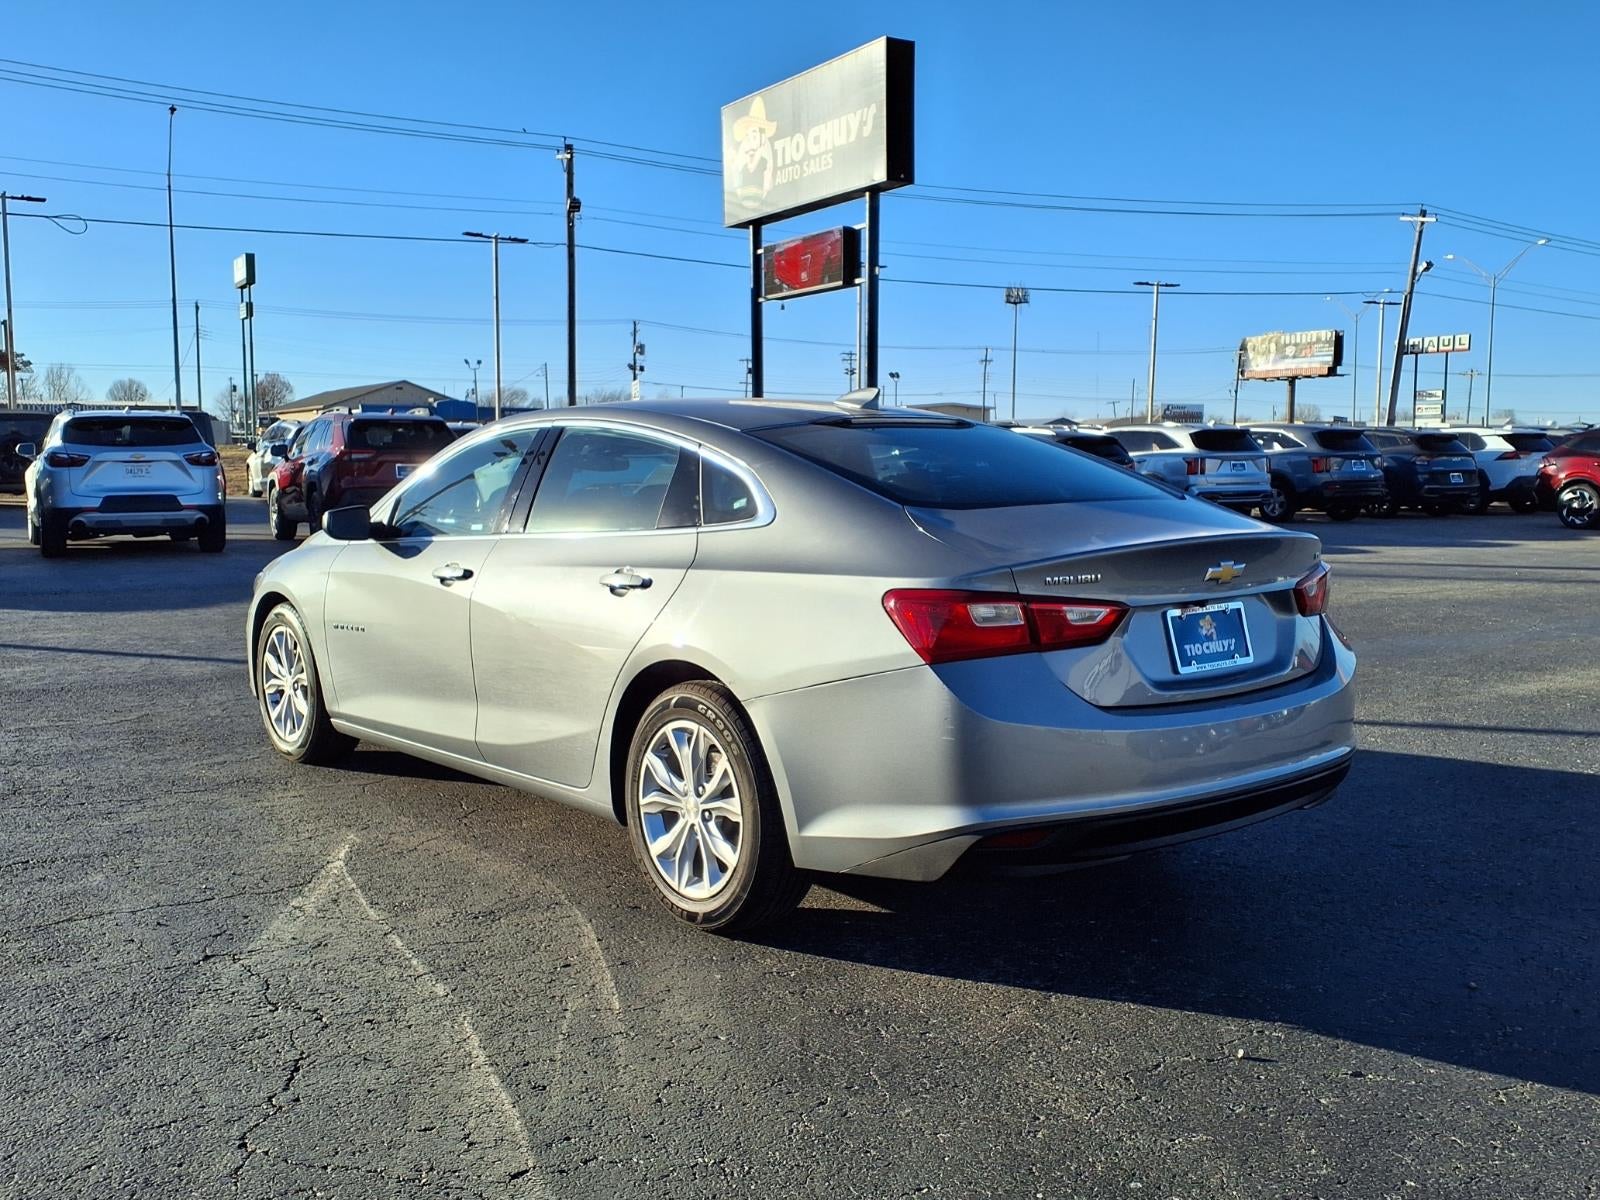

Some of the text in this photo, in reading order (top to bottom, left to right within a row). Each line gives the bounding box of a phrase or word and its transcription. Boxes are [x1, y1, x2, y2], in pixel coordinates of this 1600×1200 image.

[774, 103, 876, 167] TIO CHUY'S
[775, 153, 832, 185] AUTO SALES
[1045, 574, 1101, 585] MALIBU
[1184, 638, 1236, 657] TIO CHUY'S
[697, 703, 740, 756] GR906
